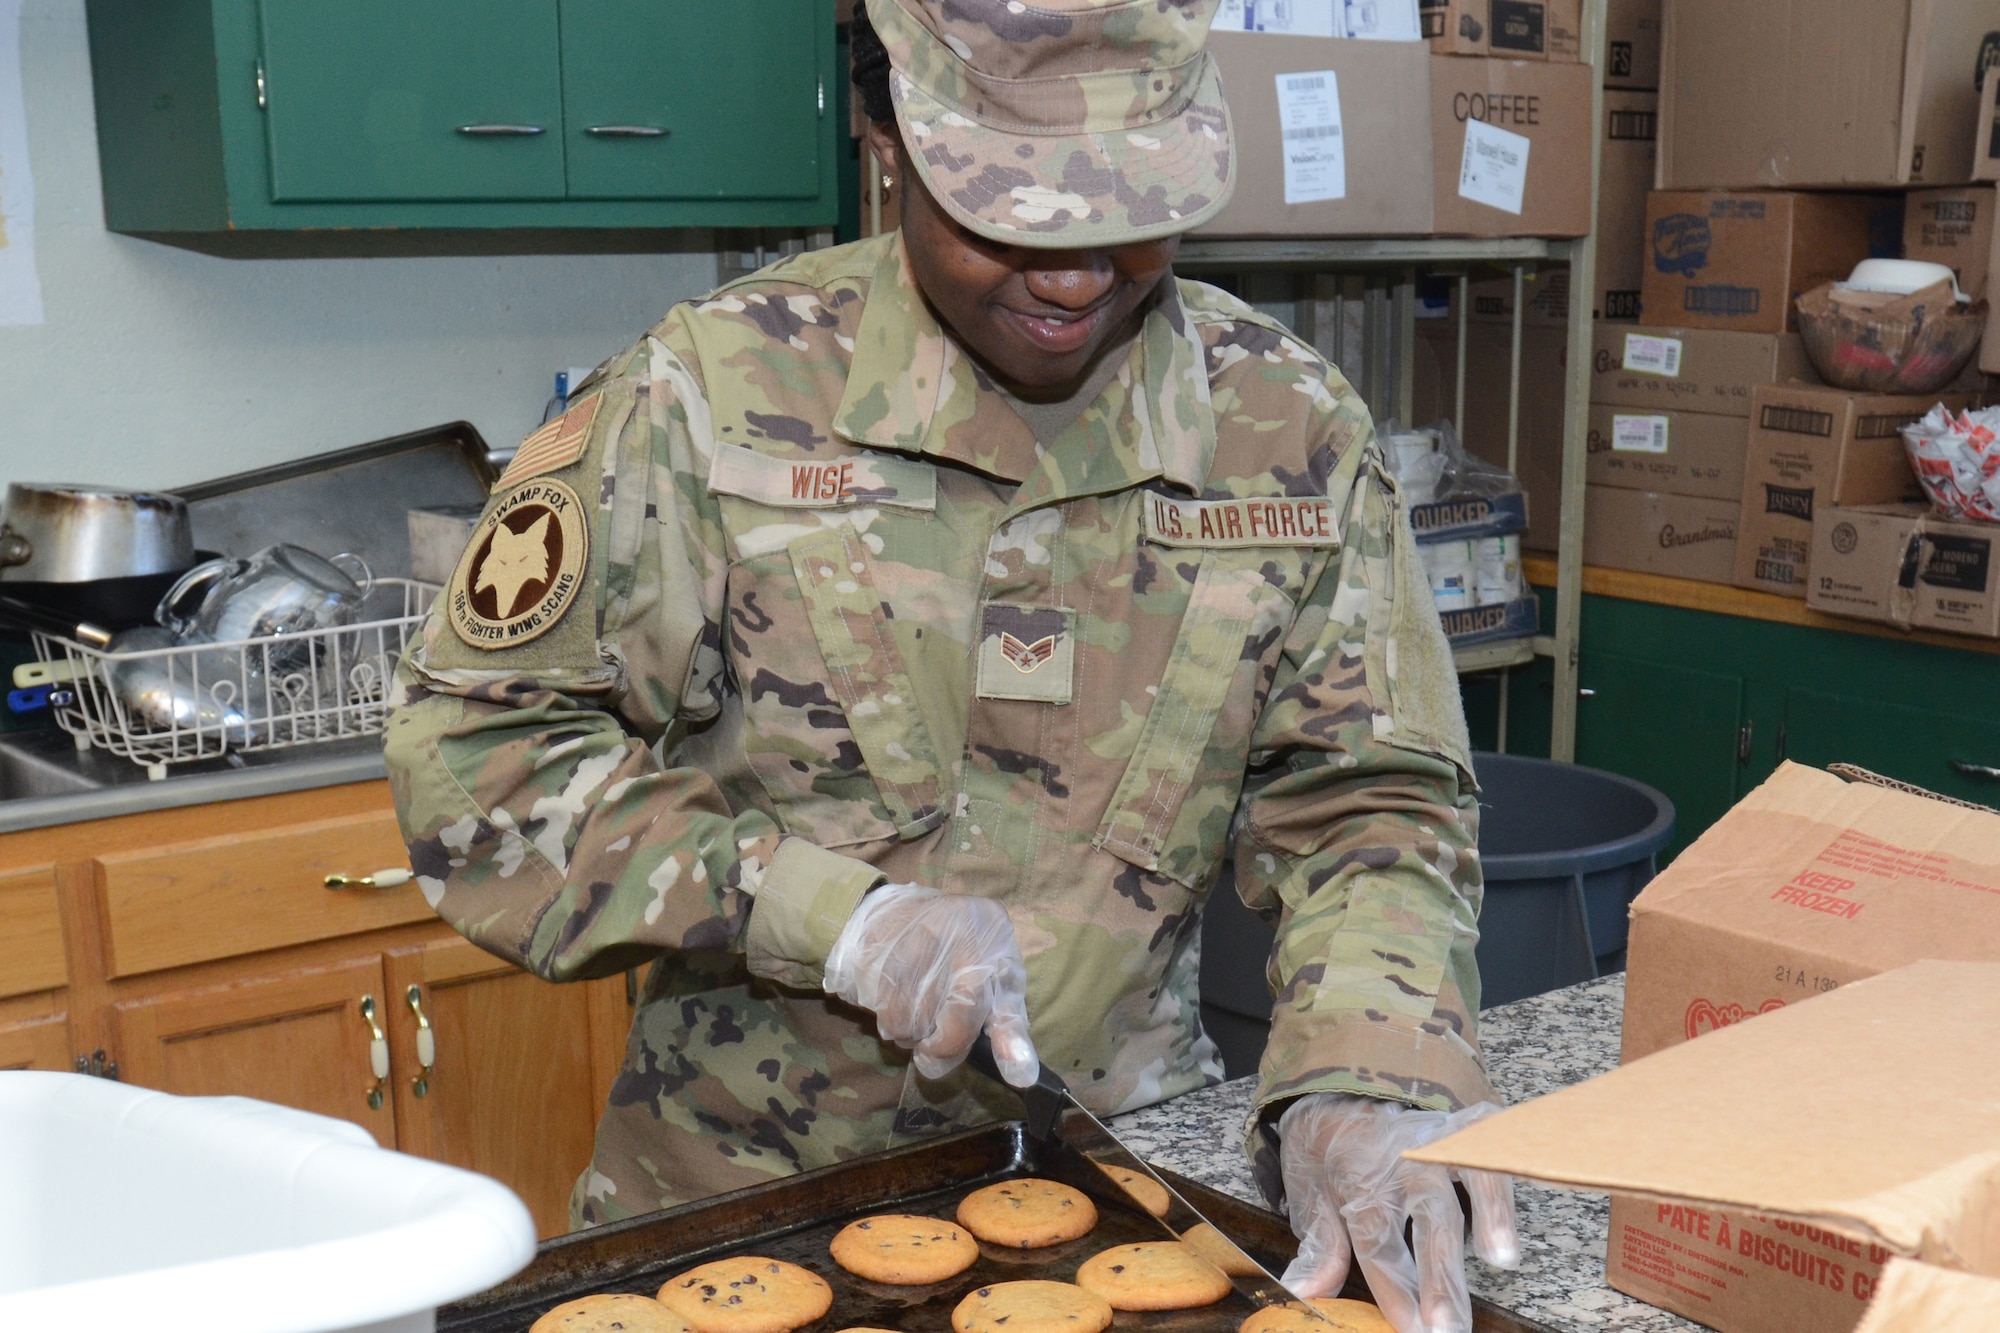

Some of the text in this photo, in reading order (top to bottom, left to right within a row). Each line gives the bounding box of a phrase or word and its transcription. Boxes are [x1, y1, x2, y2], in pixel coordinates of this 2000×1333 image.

[1453, 91, 1540, 126] COFFEE
[791, 462, 854, 500] WISE
[488, 487, 571, 528] SWAMP FOX
[1154, 499, 1332, 541] U.S. AIR FORCE
[1414, 501, 1490, 530] QUAKER
[1659, 523, 1735, 549] Grandma's
[1820, 576, 1833, 590] 12
[464, 617, 504, 639] FIGHTER
[507, 613, 542, 637] WING
[541, 573, 574, 617] SCANG
[1791, 868, 1856, 894] KEEP
[1770, 884, 1866, 920] FROZEN
[1774, 964, 1791, 984] 21
[1795, 970, 1806, 988] A
[1624, 1224, 1672, 1249] DISTRIBUTED
[1672, 1242, 1684, 1254] BY
[1716, 1213, 1731, 1251] À
[1739, 1228, 1845, 1293] BISCUITS
